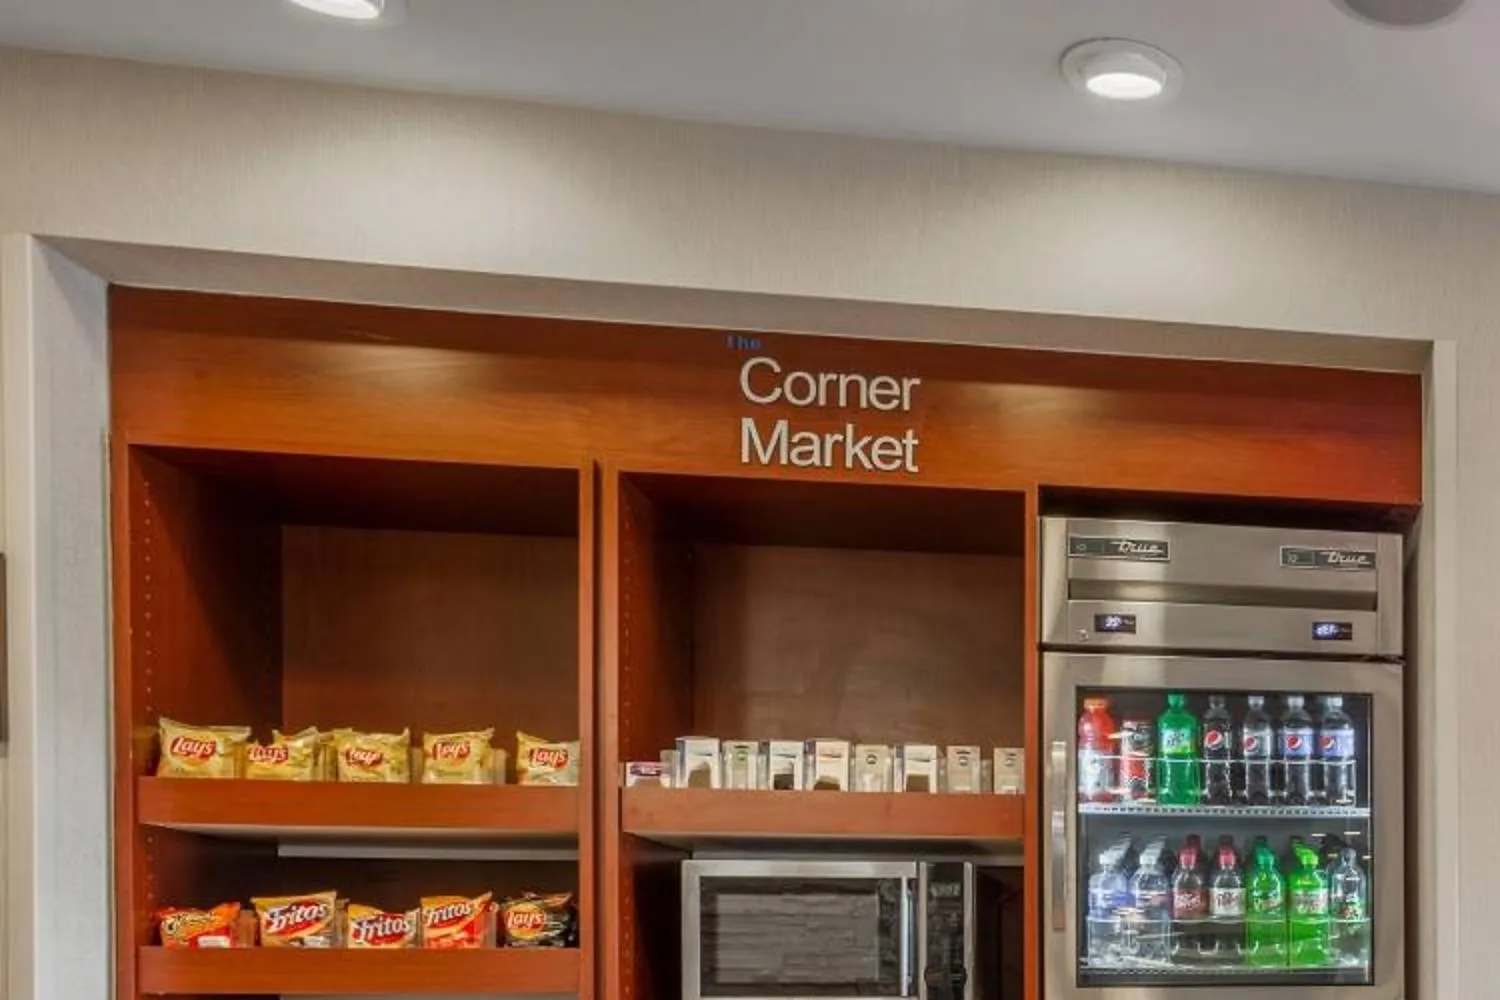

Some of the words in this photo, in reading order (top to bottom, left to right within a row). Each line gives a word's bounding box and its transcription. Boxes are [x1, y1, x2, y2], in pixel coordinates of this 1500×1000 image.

[739, 356, 922, 412] Corner
[740, 416, 920, 473] Market
[267, 902, 329, 934] Fritos
